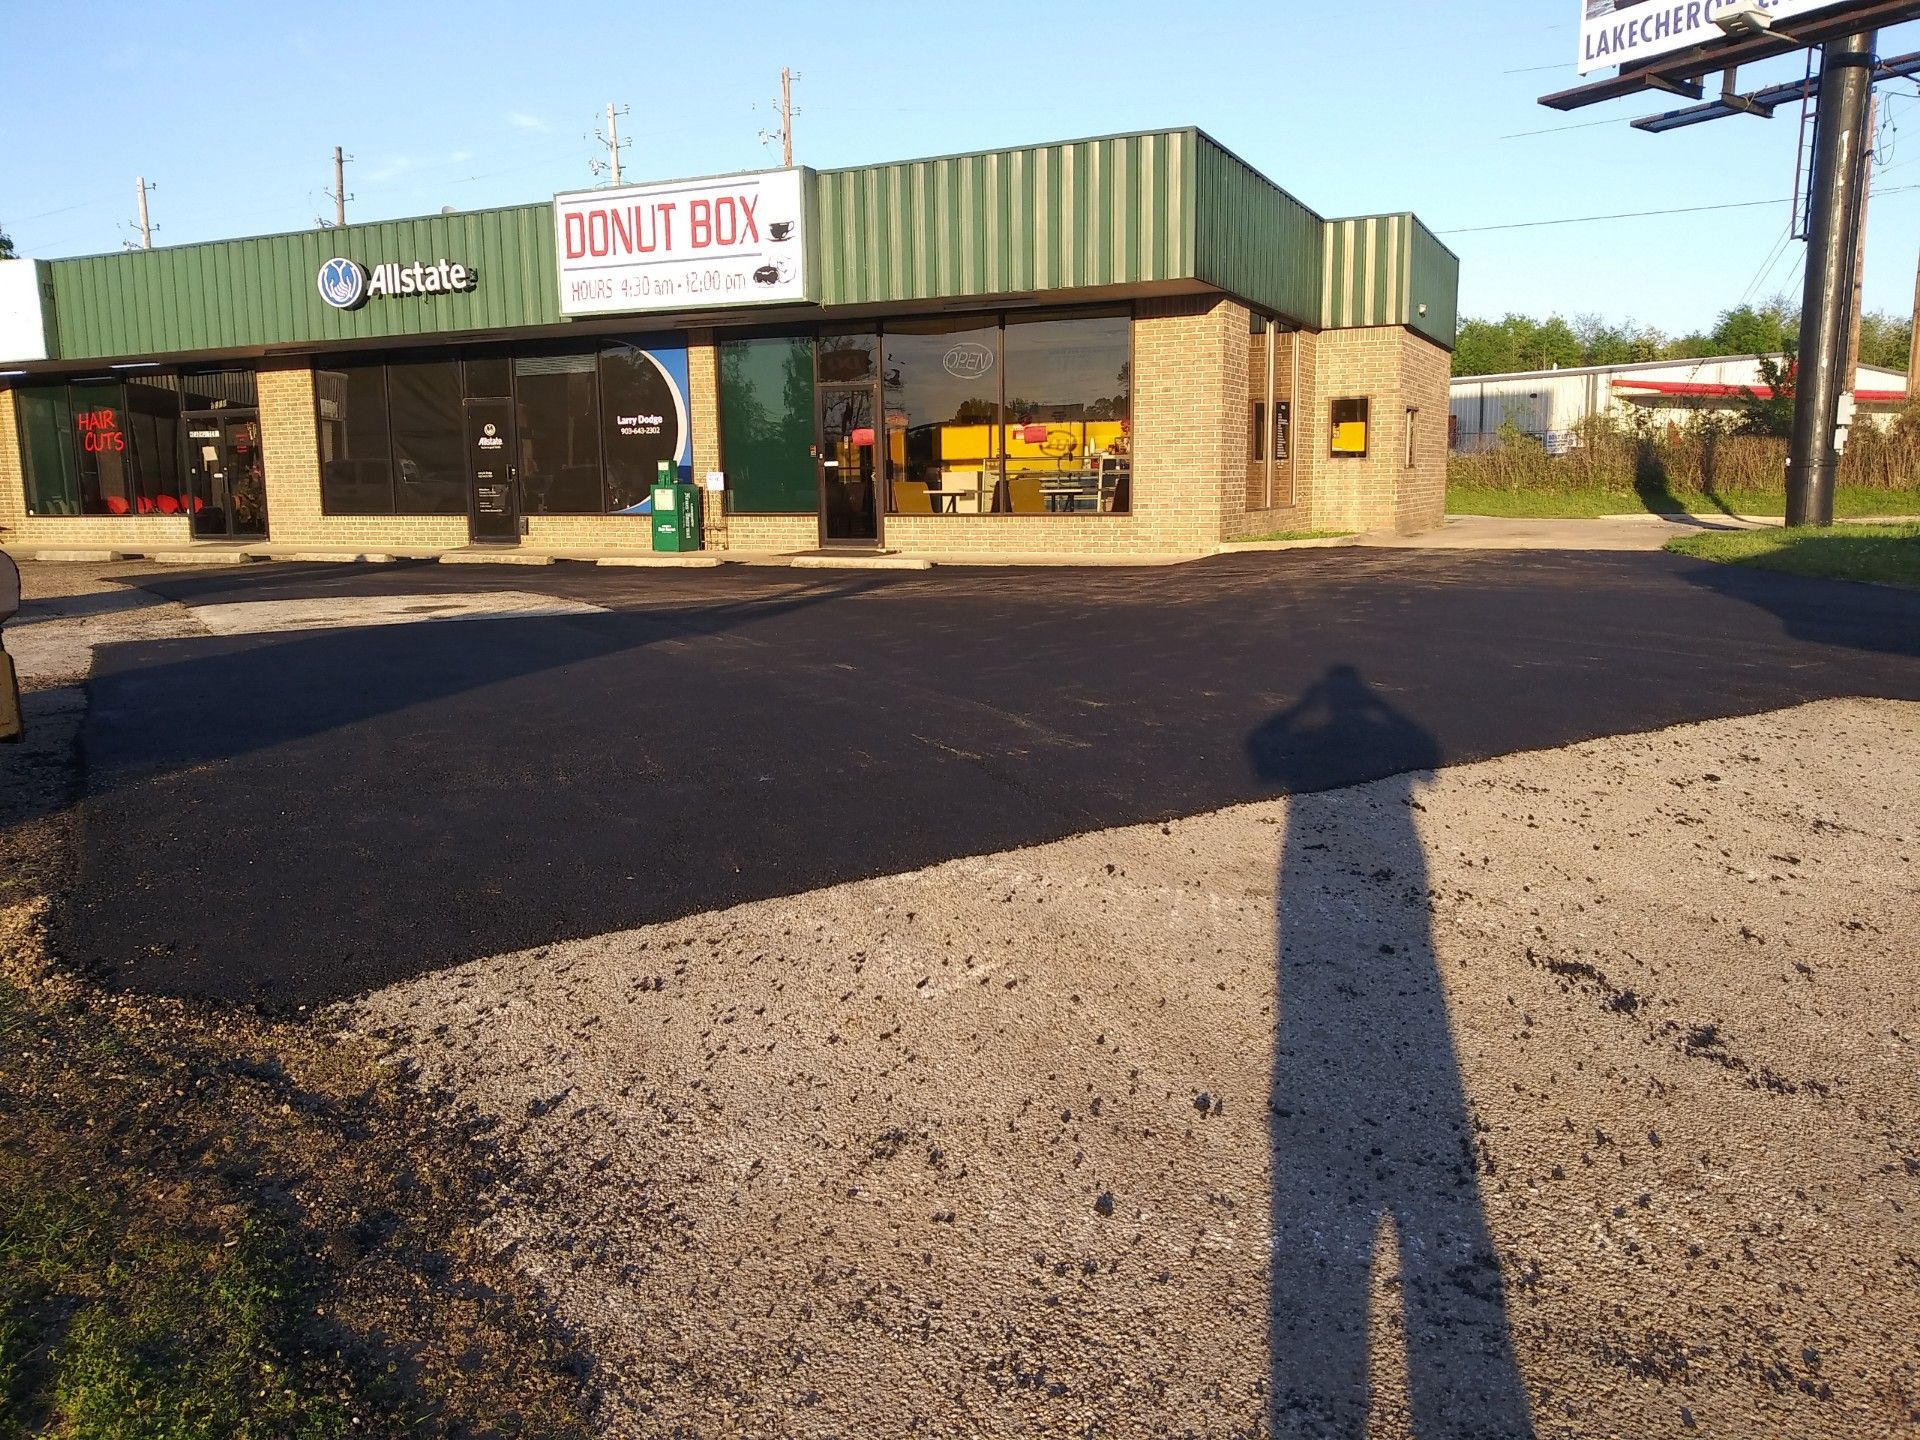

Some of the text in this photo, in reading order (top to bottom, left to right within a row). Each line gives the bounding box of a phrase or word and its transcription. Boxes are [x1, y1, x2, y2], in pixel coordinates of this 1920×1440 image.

[565, 193, 760, 259] DONUT BOX
[367, 258, 467, 297] Allstate
[571, 278, 613, 301] HOURS
[620, 275, 650, 297] 4:30
[654, 279, 674, 296] am
[685, 270, 720, 293] 12:00
[725, 273, 746, 290] pm
[946, 352, 988, 369] OPEN
[79, 410, 115, 430] HAIR
[617, 414, 663, 426] Larry Dodge
[620, 426, 661, 435] 903-643-2302
[85, 432, 124, 451] CUTS
